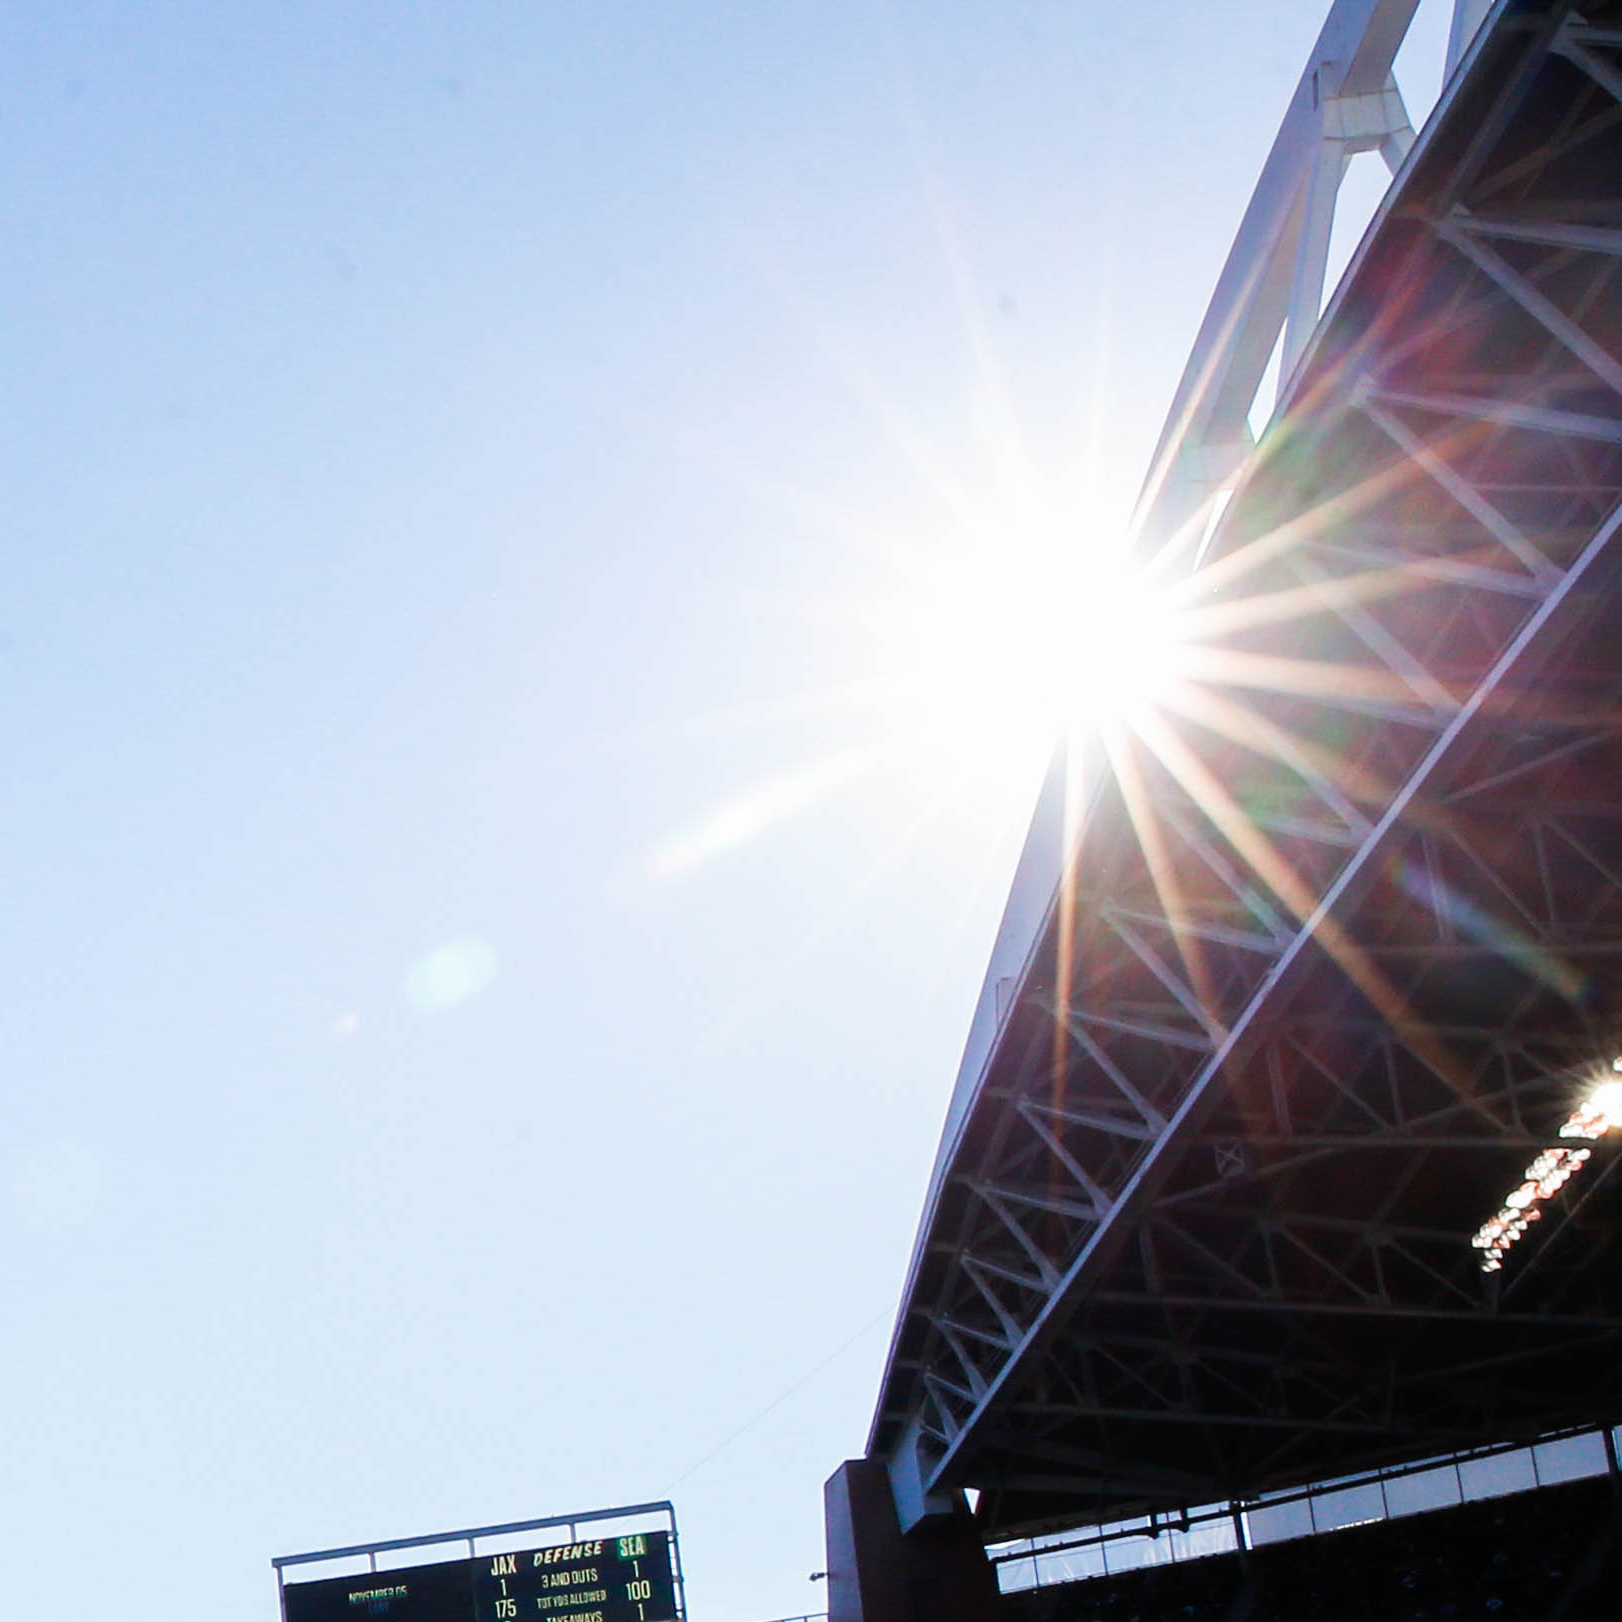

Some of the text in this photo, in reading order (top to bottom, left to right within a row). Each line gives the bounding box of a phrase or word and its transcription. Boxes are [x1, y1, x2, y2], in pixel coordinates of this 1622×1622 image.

[533, 1541, 603, 1568] DEFENSE
[620, 1537, 644, 1557] SEA
[491, 1554, 517, 1575] JAX
[632, 1561, 639, 1578] 1
[499, 1579, 506, 1596] 1
[542, 1568, 598, 1589] 3 AND OUTS
[573, 1589, 606, 1606] ALLOWED
[626, 1579, 651, 1601] 100
[495, 1598, 517, 1619] 175
[638, 1604, 645, 1621] 1
